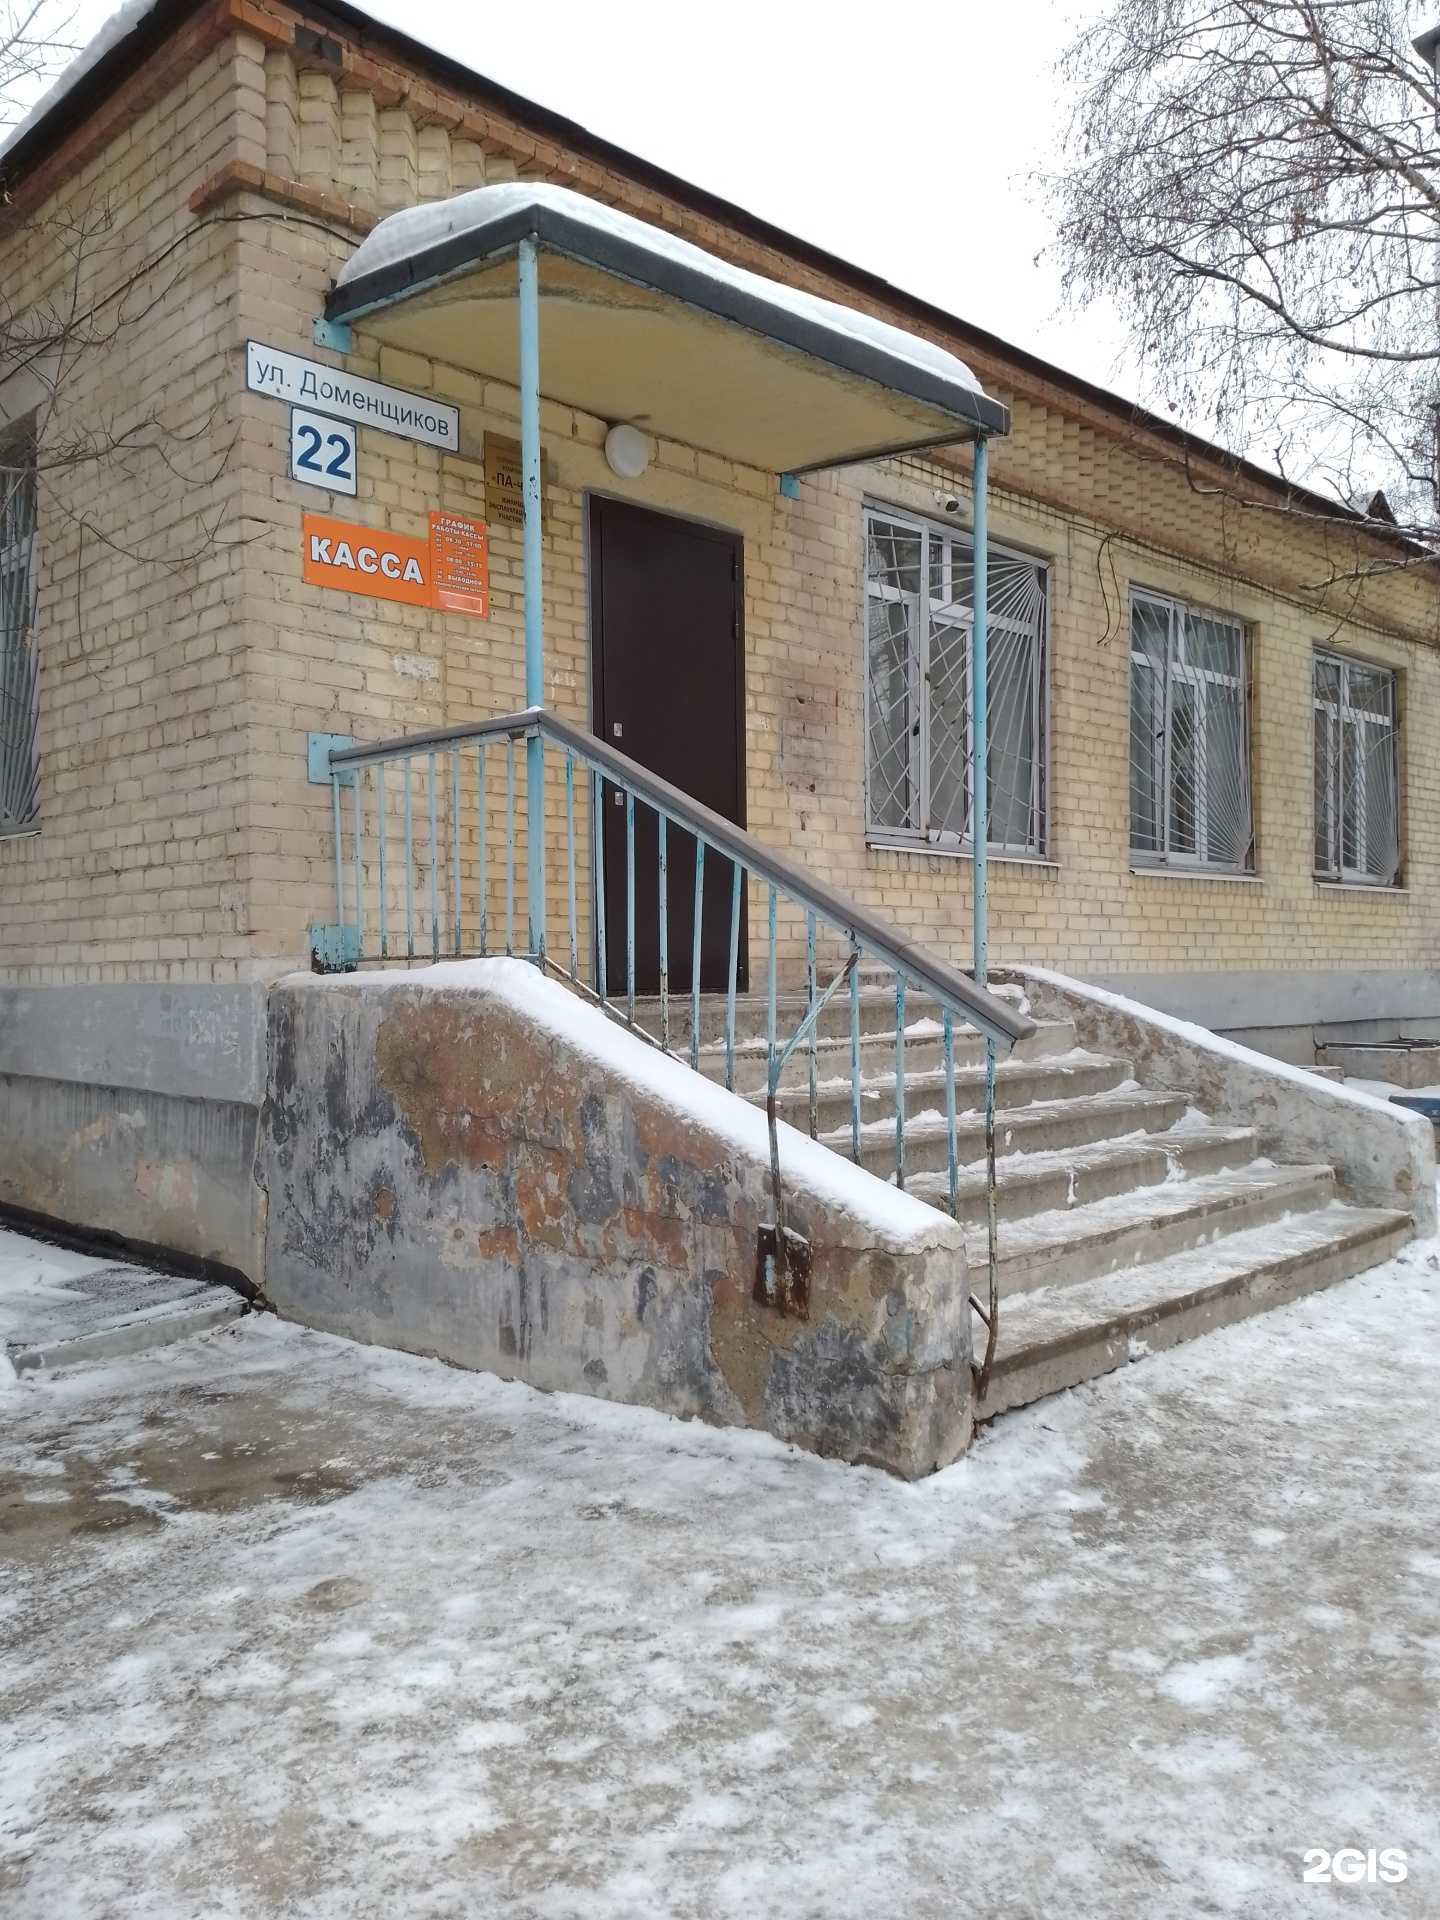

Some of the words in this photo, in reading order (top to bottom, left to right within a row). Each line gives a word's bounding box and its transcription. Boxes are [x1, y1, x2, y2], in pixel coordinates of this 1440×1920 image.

[256, 360, 291, 386] ул.
[300, 370, 449, 436] Доменщиков
[296, 425, 352, 480] 22
[431, 523, 460, 535] РАБОТЫ
[461, 530, 484, 541] КАССЫ
[440, 517, 475, 533] ГРАФИК
[310, 535, 425, 584] КАССА
